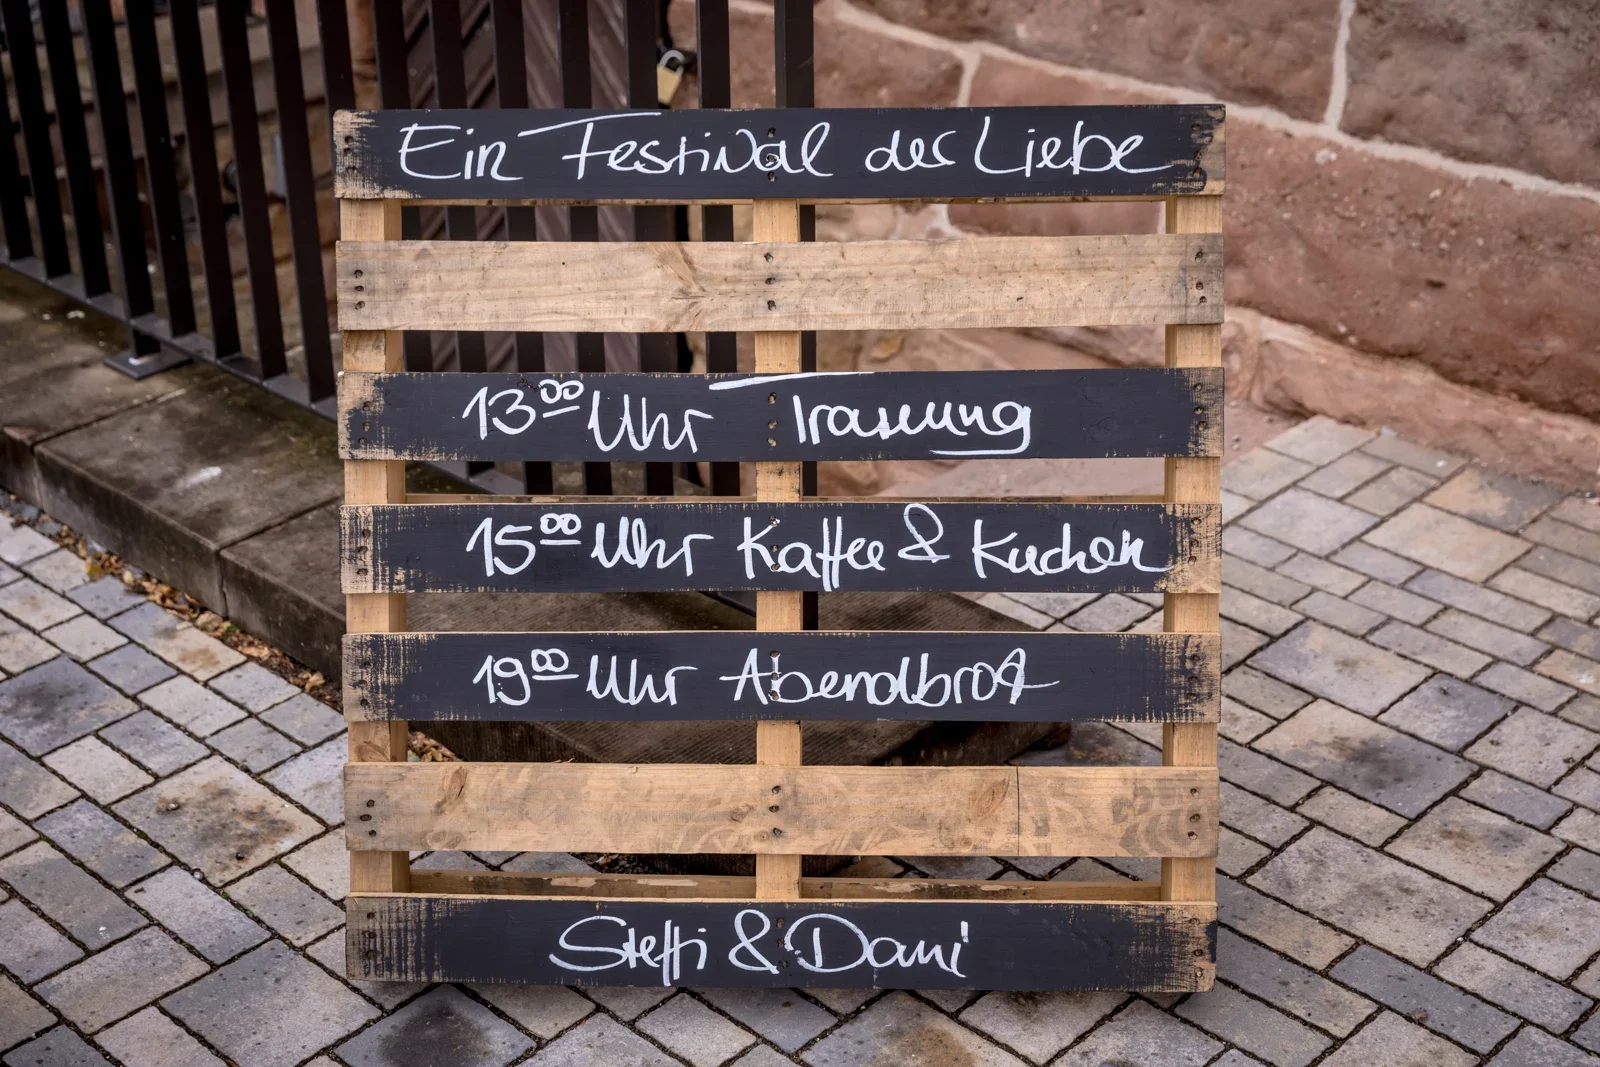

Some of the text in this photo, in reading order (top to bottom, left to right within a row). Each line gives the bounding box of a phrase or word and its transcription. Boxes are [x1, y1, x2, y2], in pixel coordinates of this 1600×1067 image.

[398, 112, 1174, 181] Ein Festival der Liebe
[588, 390, 714, 453] Uhr
[708, 372, 1032, 455] Trauung
[591, 517, 713, 576] Uhr
[737, 516, 885, 592] Kaffee
[898, 503, 950, 563] &
[972, 519, 1173, 579] Kuchen
[586, 655, 697, 706] Uhr
[719, 648, 1060, 707] Abendbrot
[549, 915, 708, 987] Steffi
[728, 909, 780, 974] &
